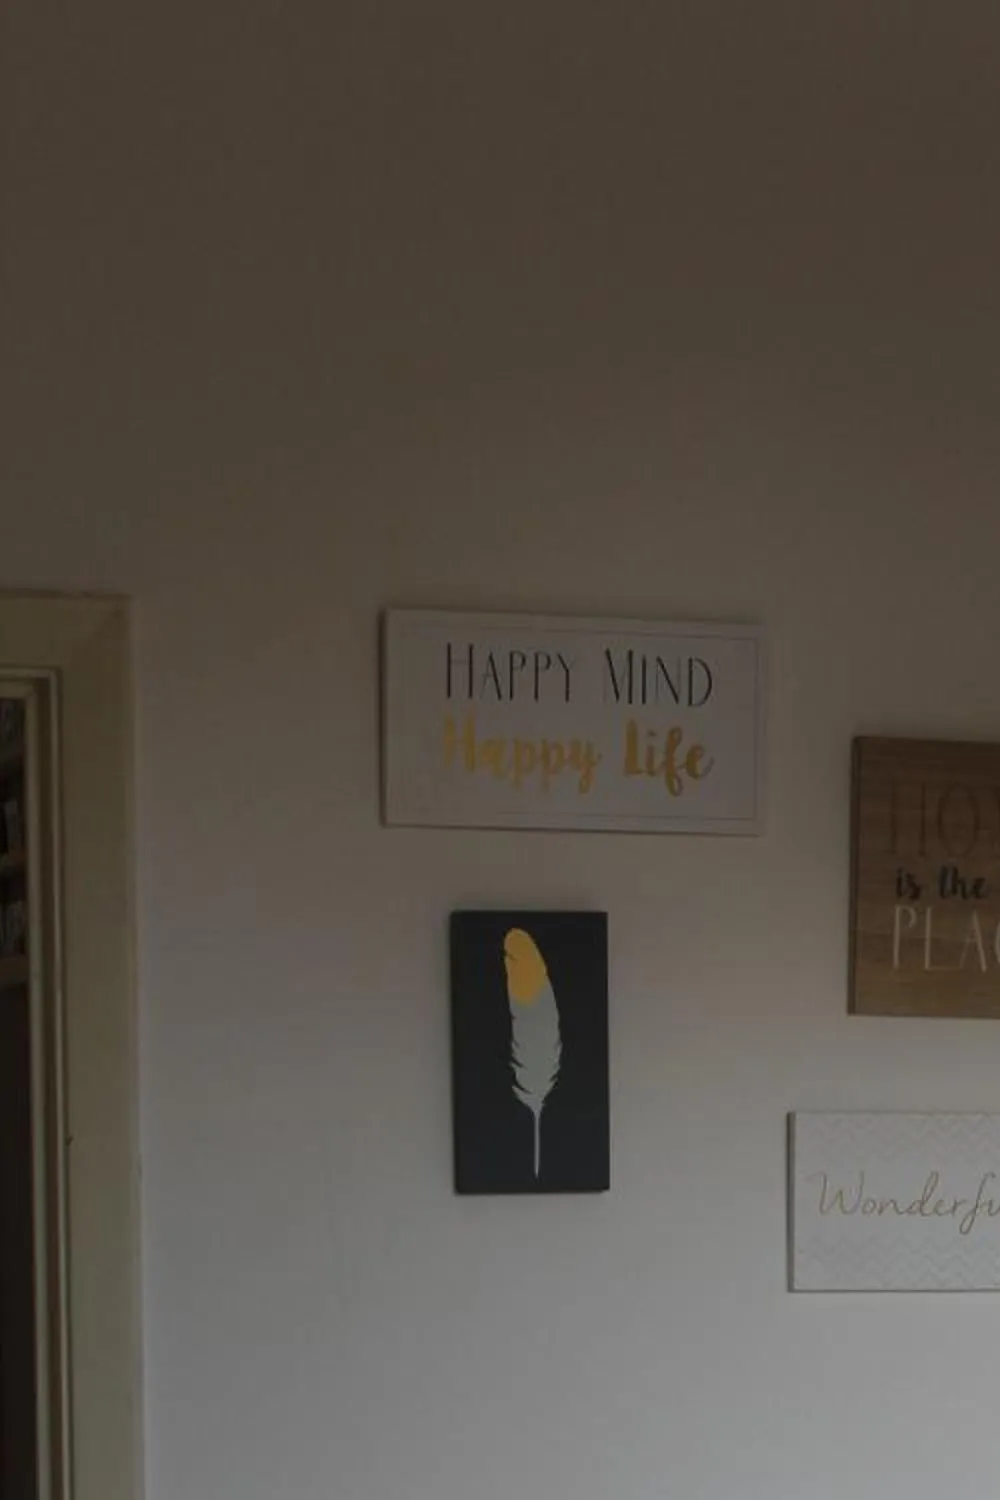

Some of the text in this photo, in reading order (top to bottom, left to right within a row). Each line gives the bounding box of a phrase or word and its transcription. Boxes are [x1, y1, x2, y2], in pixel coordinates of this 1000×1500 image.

[446, 642, 715, 708] HAPPY MIND
[442, 706, 716, 798] Happy Life
[895, 866, 922, 901] is
[938, 864, 987, 901] the
